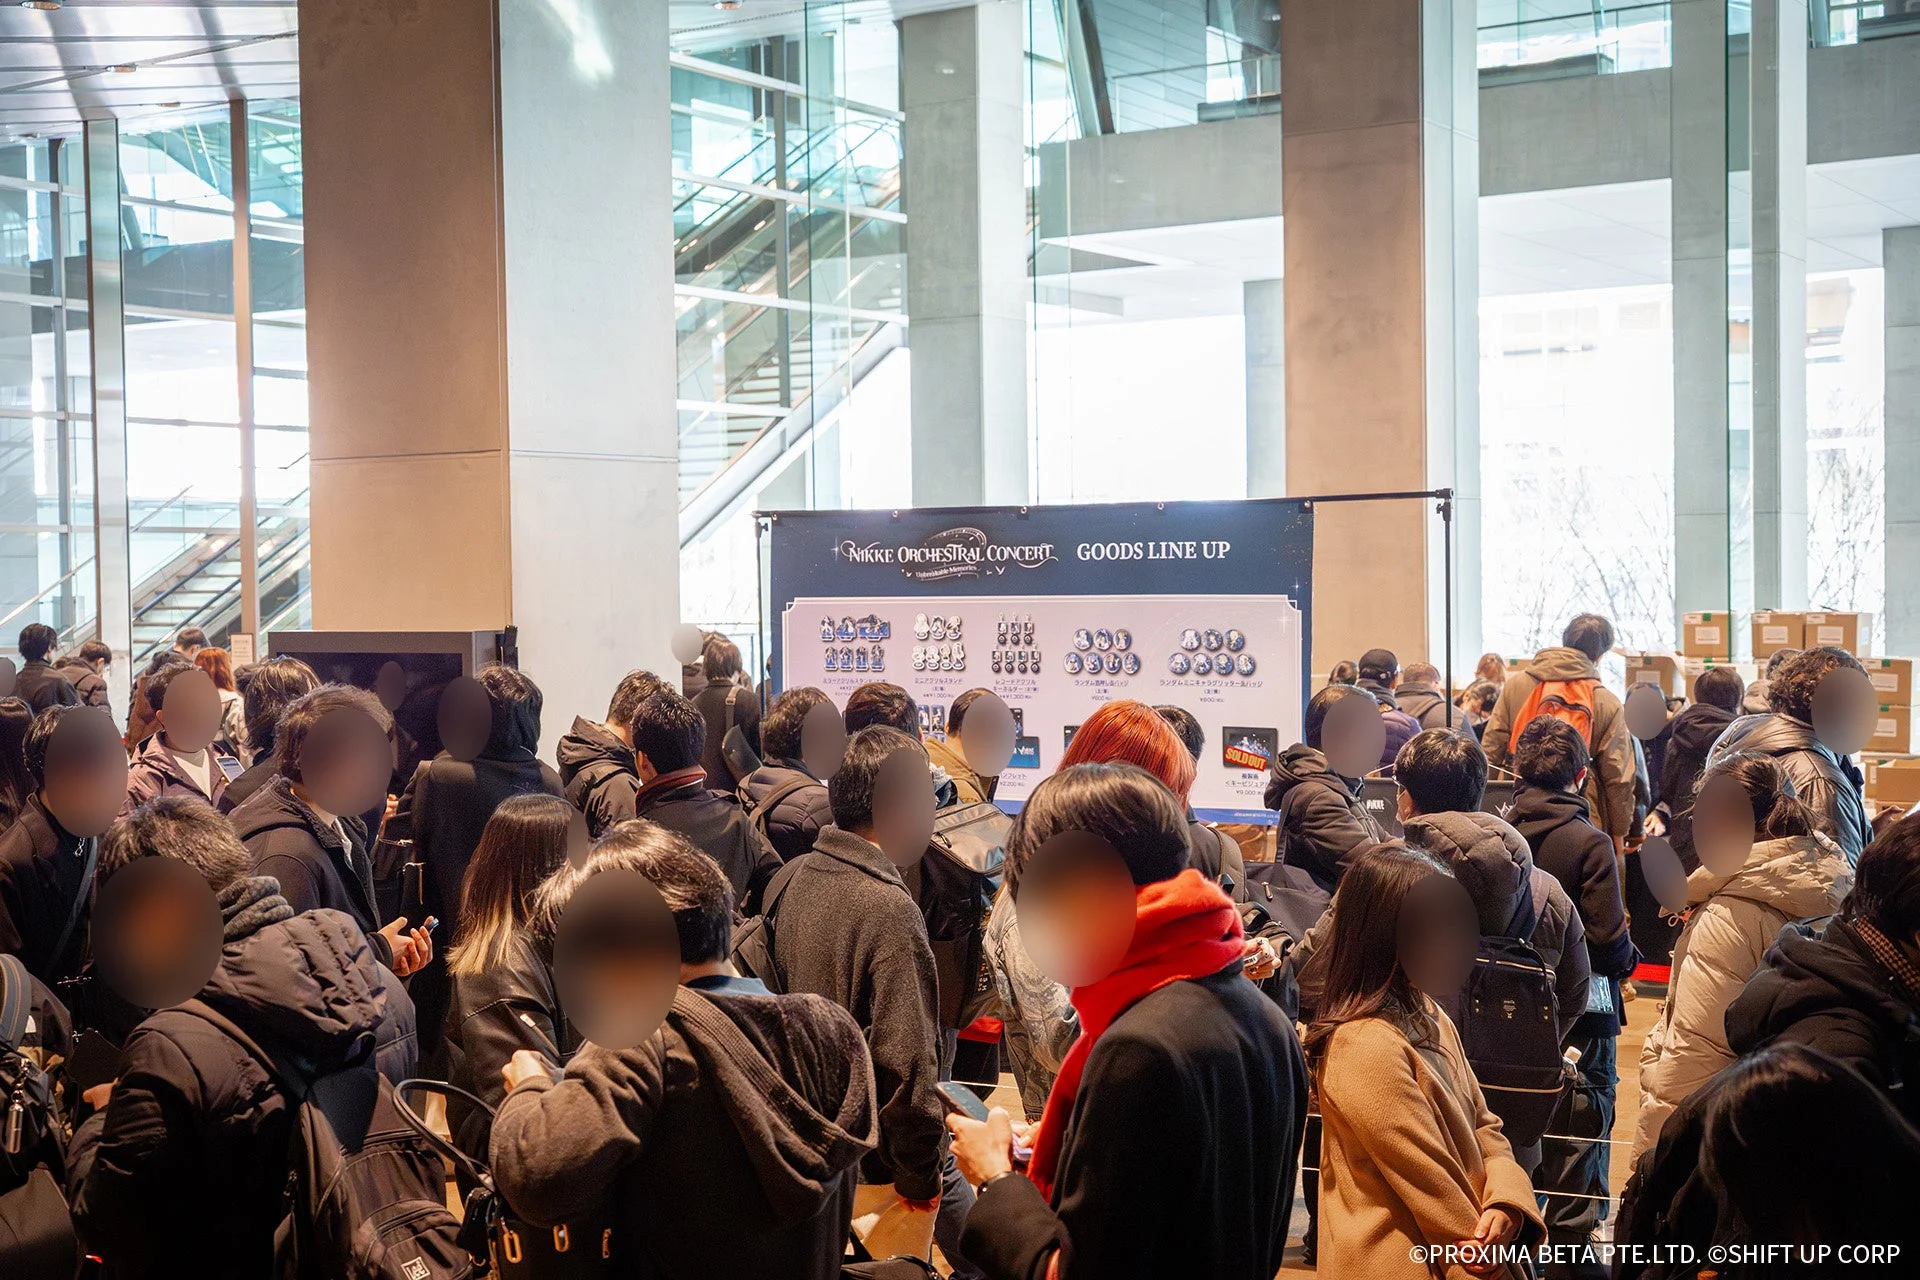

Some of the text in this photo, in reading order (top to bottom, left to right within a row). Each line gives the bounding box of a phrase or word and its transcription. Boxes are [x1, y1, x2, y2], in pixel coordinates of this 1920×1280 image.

[842, 541, 1057, 566] NIKKE ORCHESTRAL CONCERT
[1077, 541, 1231, 561] GOODS LINE UP
[1225, 747, 1267, 770] SOLD OUT
